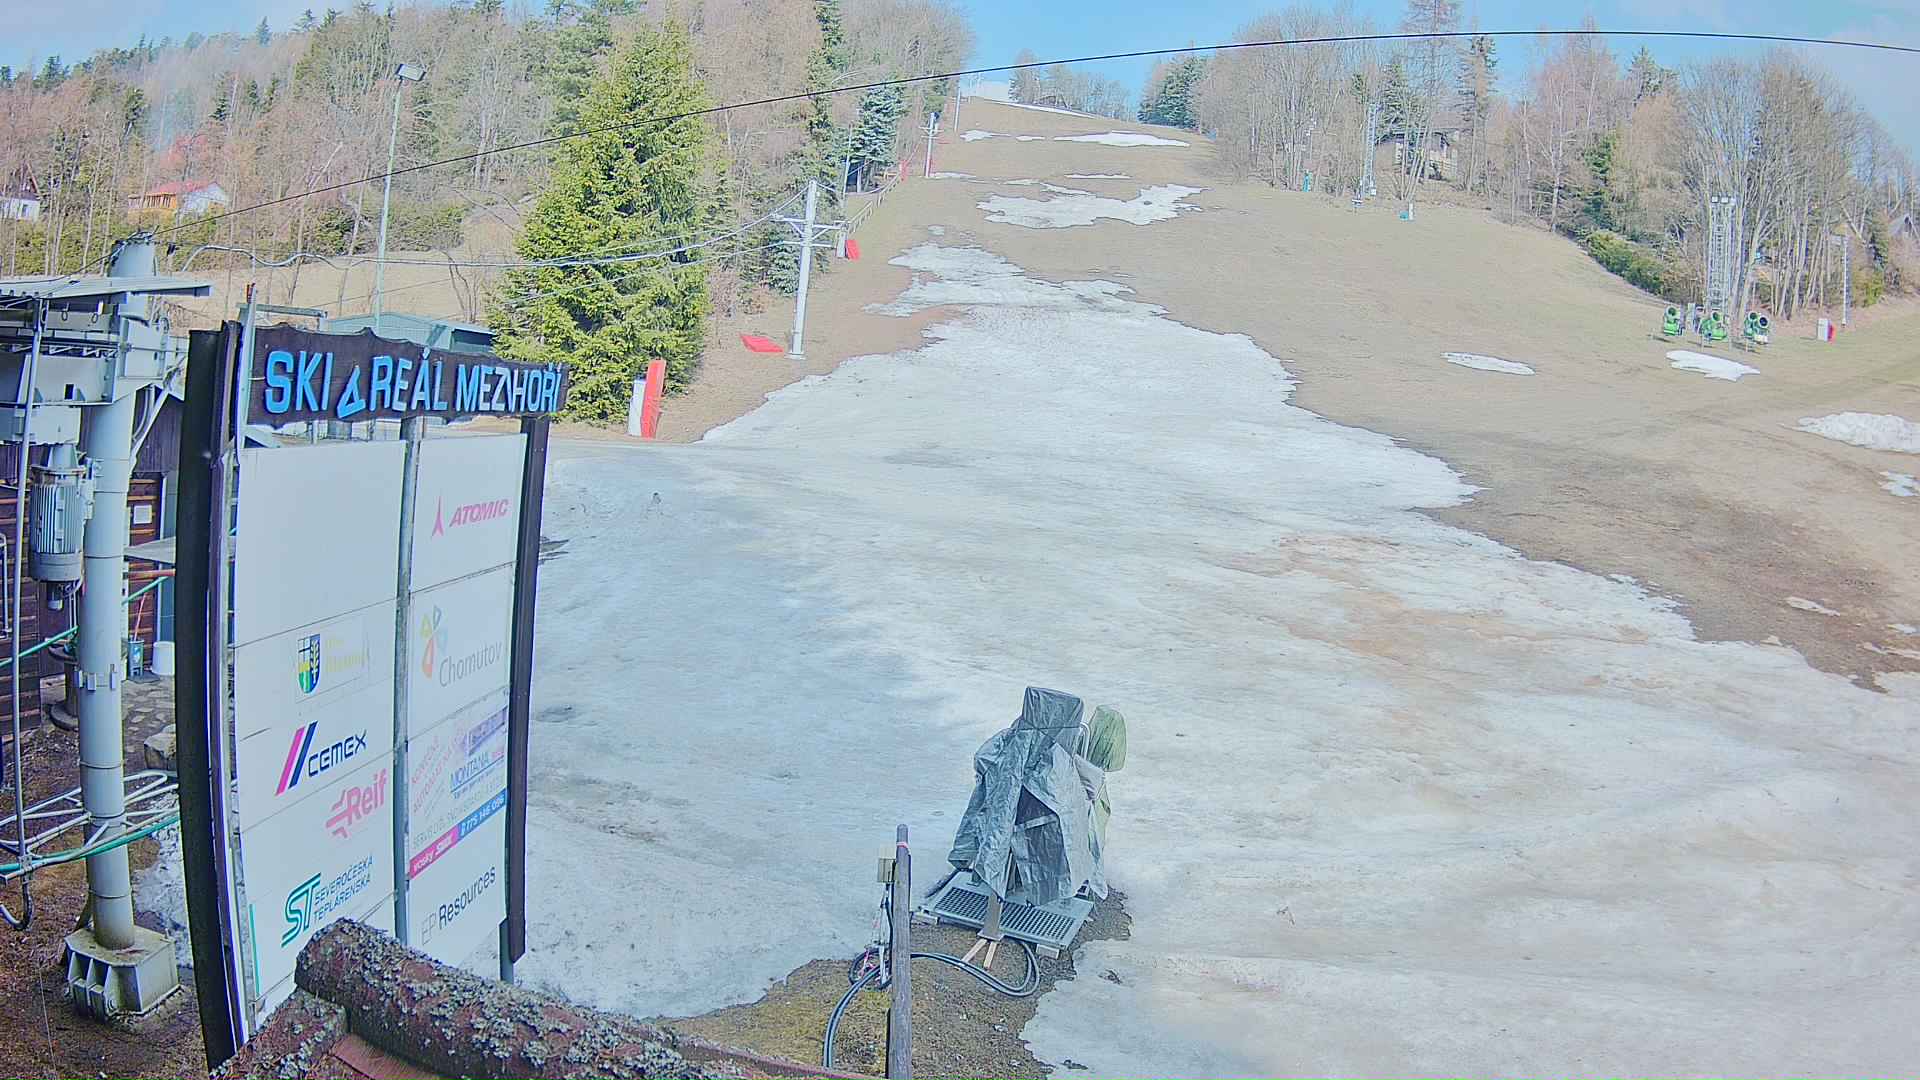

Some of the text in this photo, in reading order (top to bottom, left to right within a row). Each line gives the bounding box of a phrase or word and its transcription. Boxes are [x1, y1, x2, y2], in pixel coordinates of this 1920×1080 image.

[265, 350, 333, 414] SKI
[450, 499, 509, 528] ATOMIC
[439, 641, 502, 688] Chomutov
[308, 729, 367, 778] CEMEX
[347, 768, 387, 826] Reif
[438, 867, 495, 930] Resources
